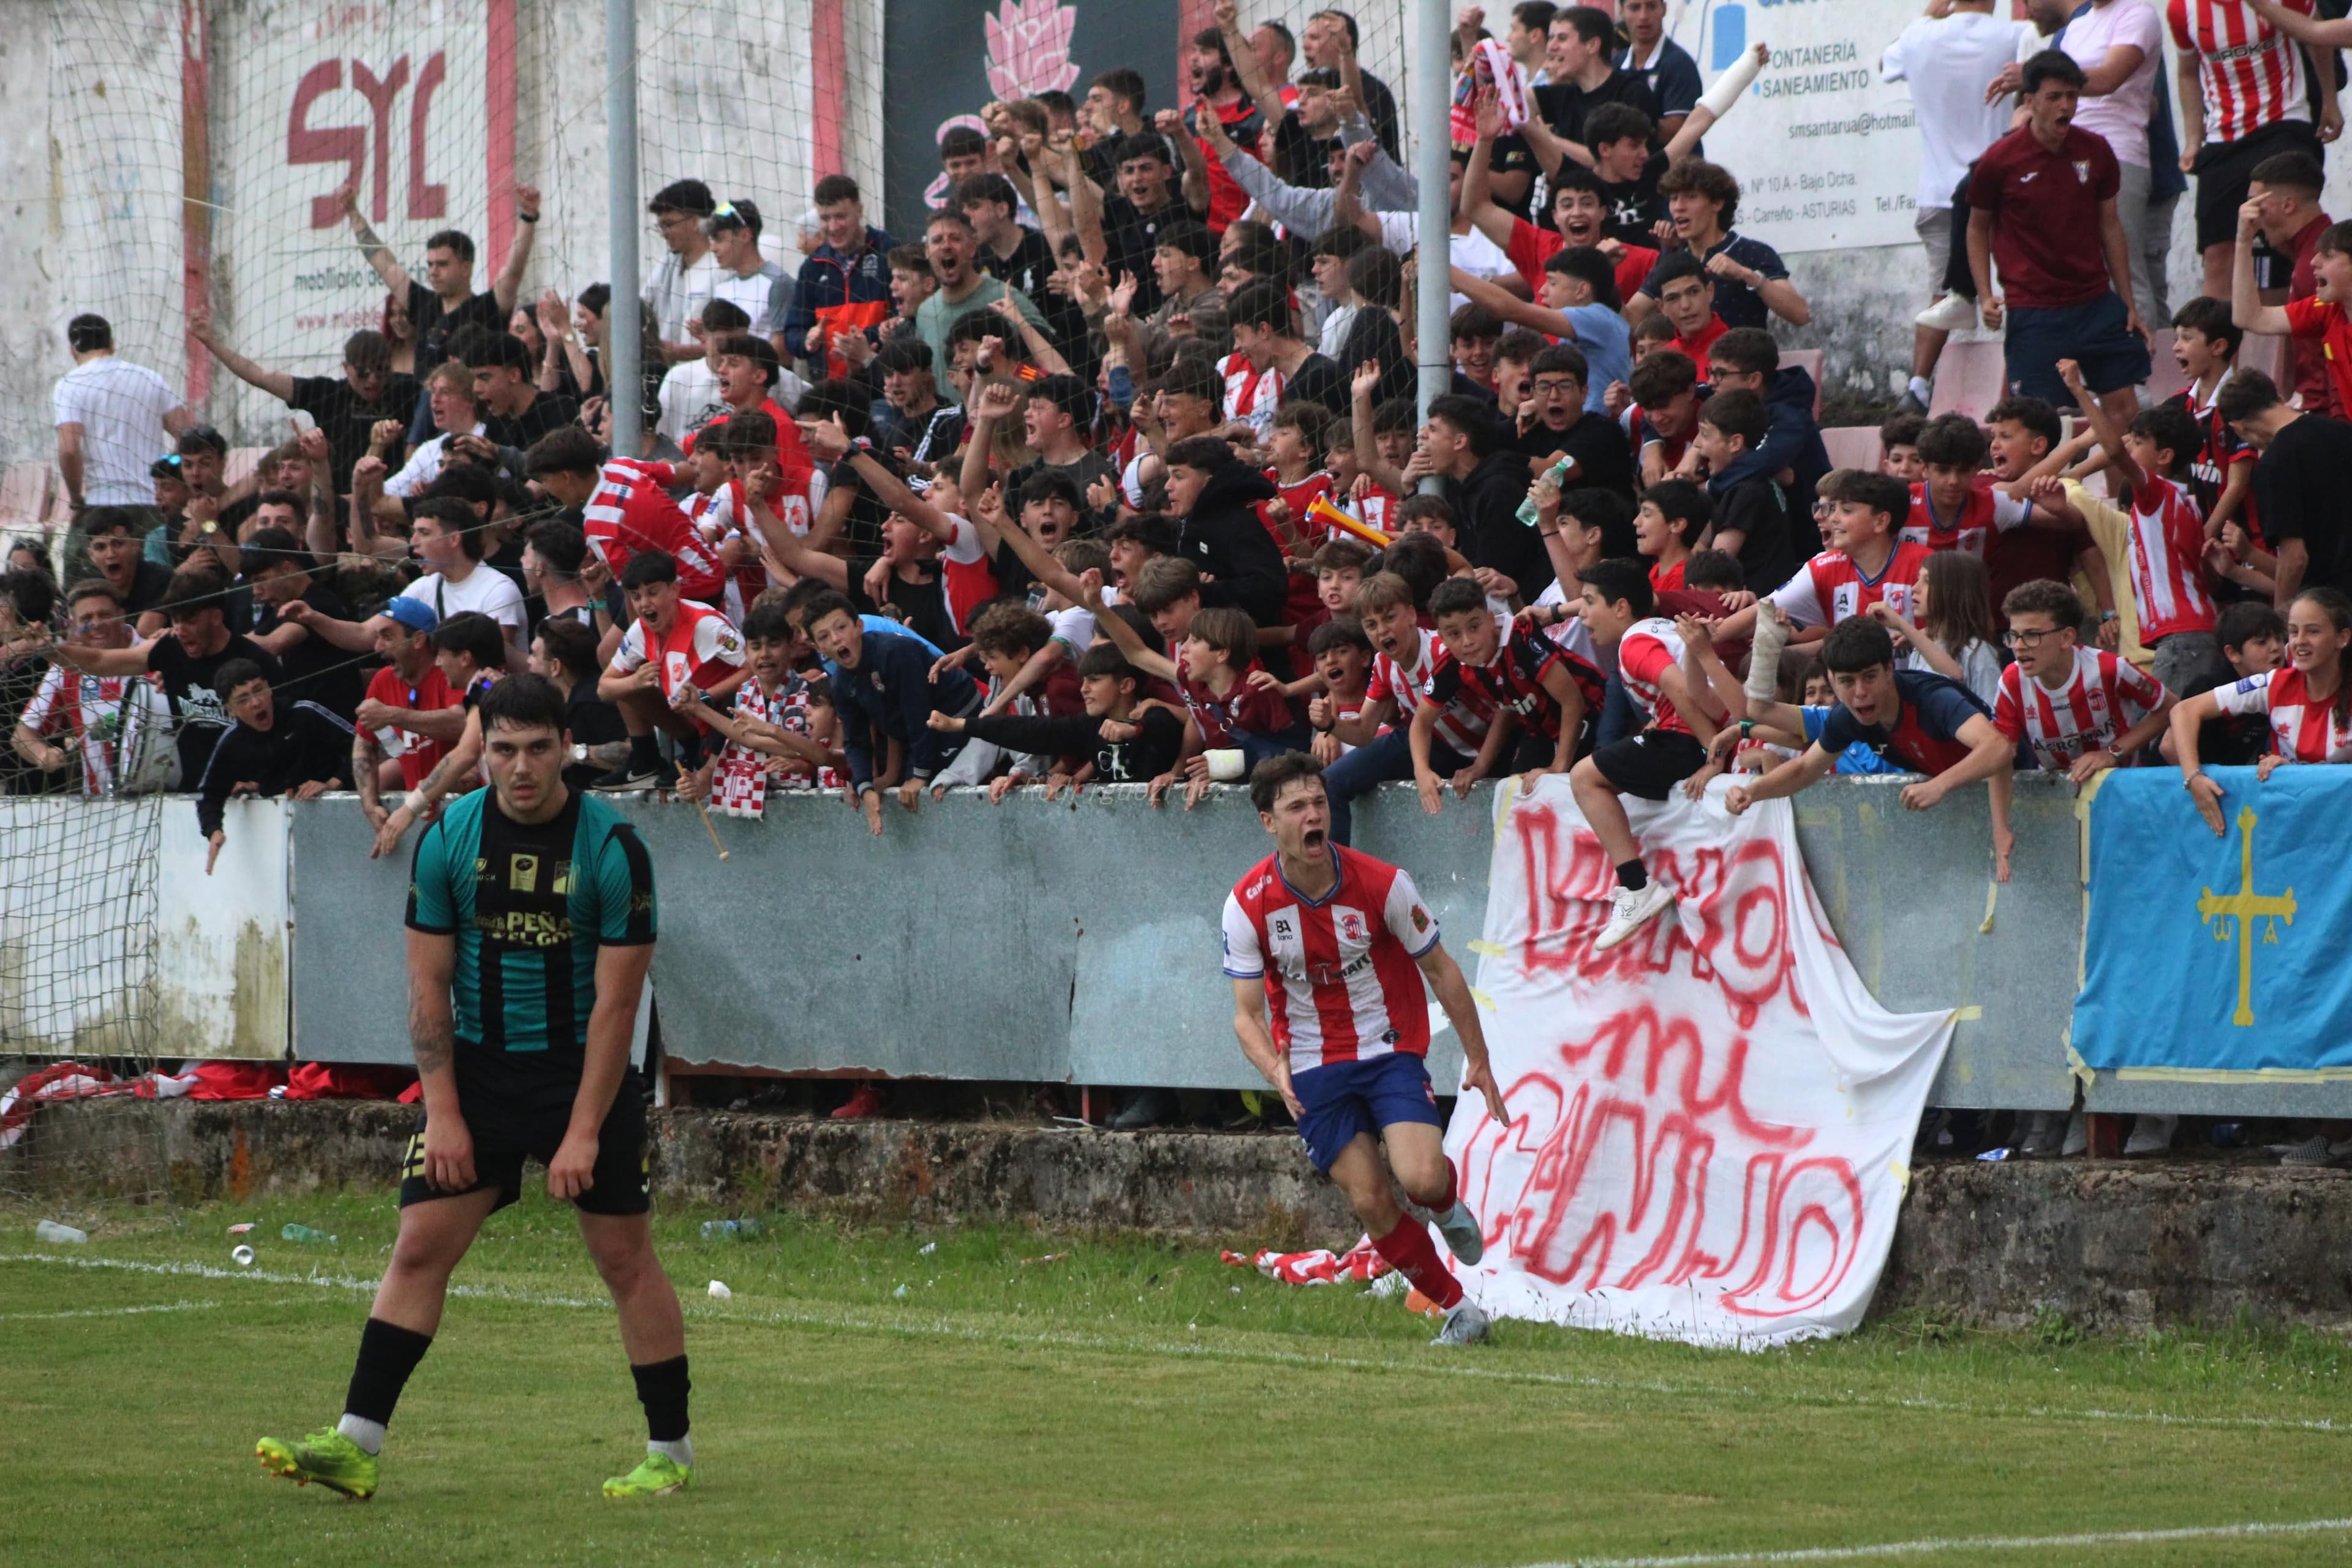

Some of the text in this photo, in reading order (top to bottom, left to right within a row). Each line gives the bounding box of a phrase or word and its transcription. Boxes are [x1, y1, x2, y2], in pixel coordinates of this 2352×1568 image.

[1762, 70, 1869, 98] SANEAMIENTO
[1788, 111, 1919, 139] smsantarua@hotmail.
[1768, 176, 1780, 192] 10
[1800, 174, 1825, 192] Bajo
[1752, 206, 1793, 224] Carreño
[1801, 199, 1856, 220] ASTURIAS
